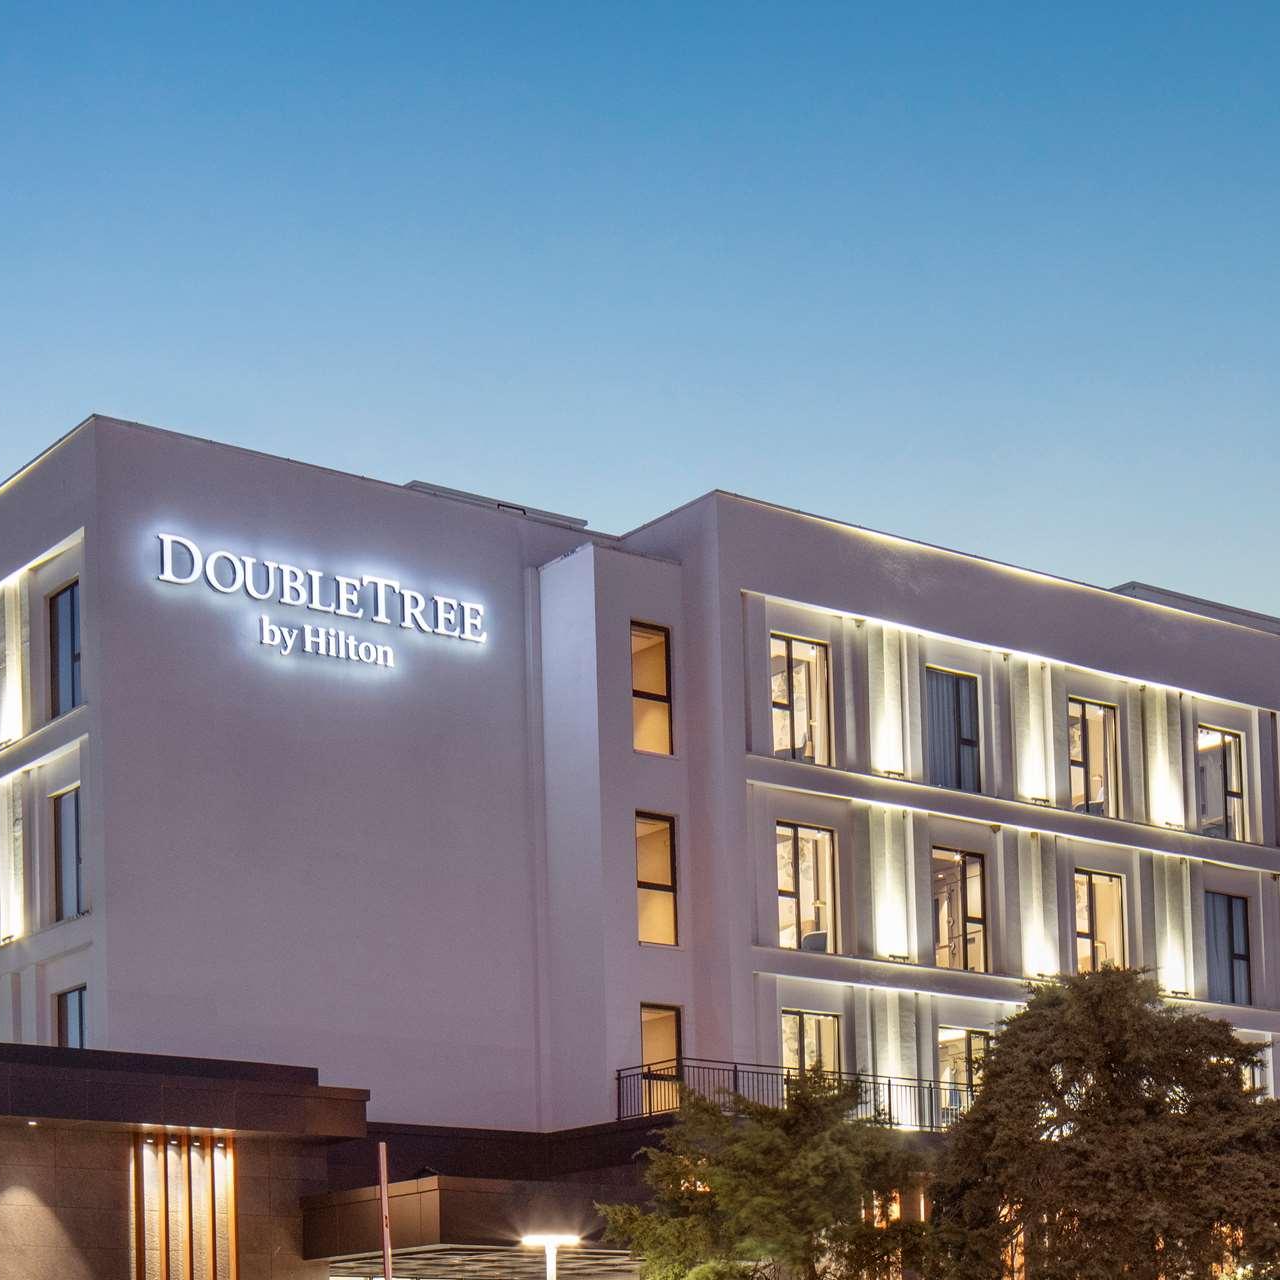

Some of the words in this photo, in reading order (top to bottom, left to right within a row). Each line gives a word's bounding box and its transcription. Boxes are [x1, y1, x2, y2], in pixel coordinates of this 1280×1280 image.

[157, 533, 487, 643] DOUBLETREE
[259, 614, 299, 656] by
[303, 624, 395, 668] Hilton
